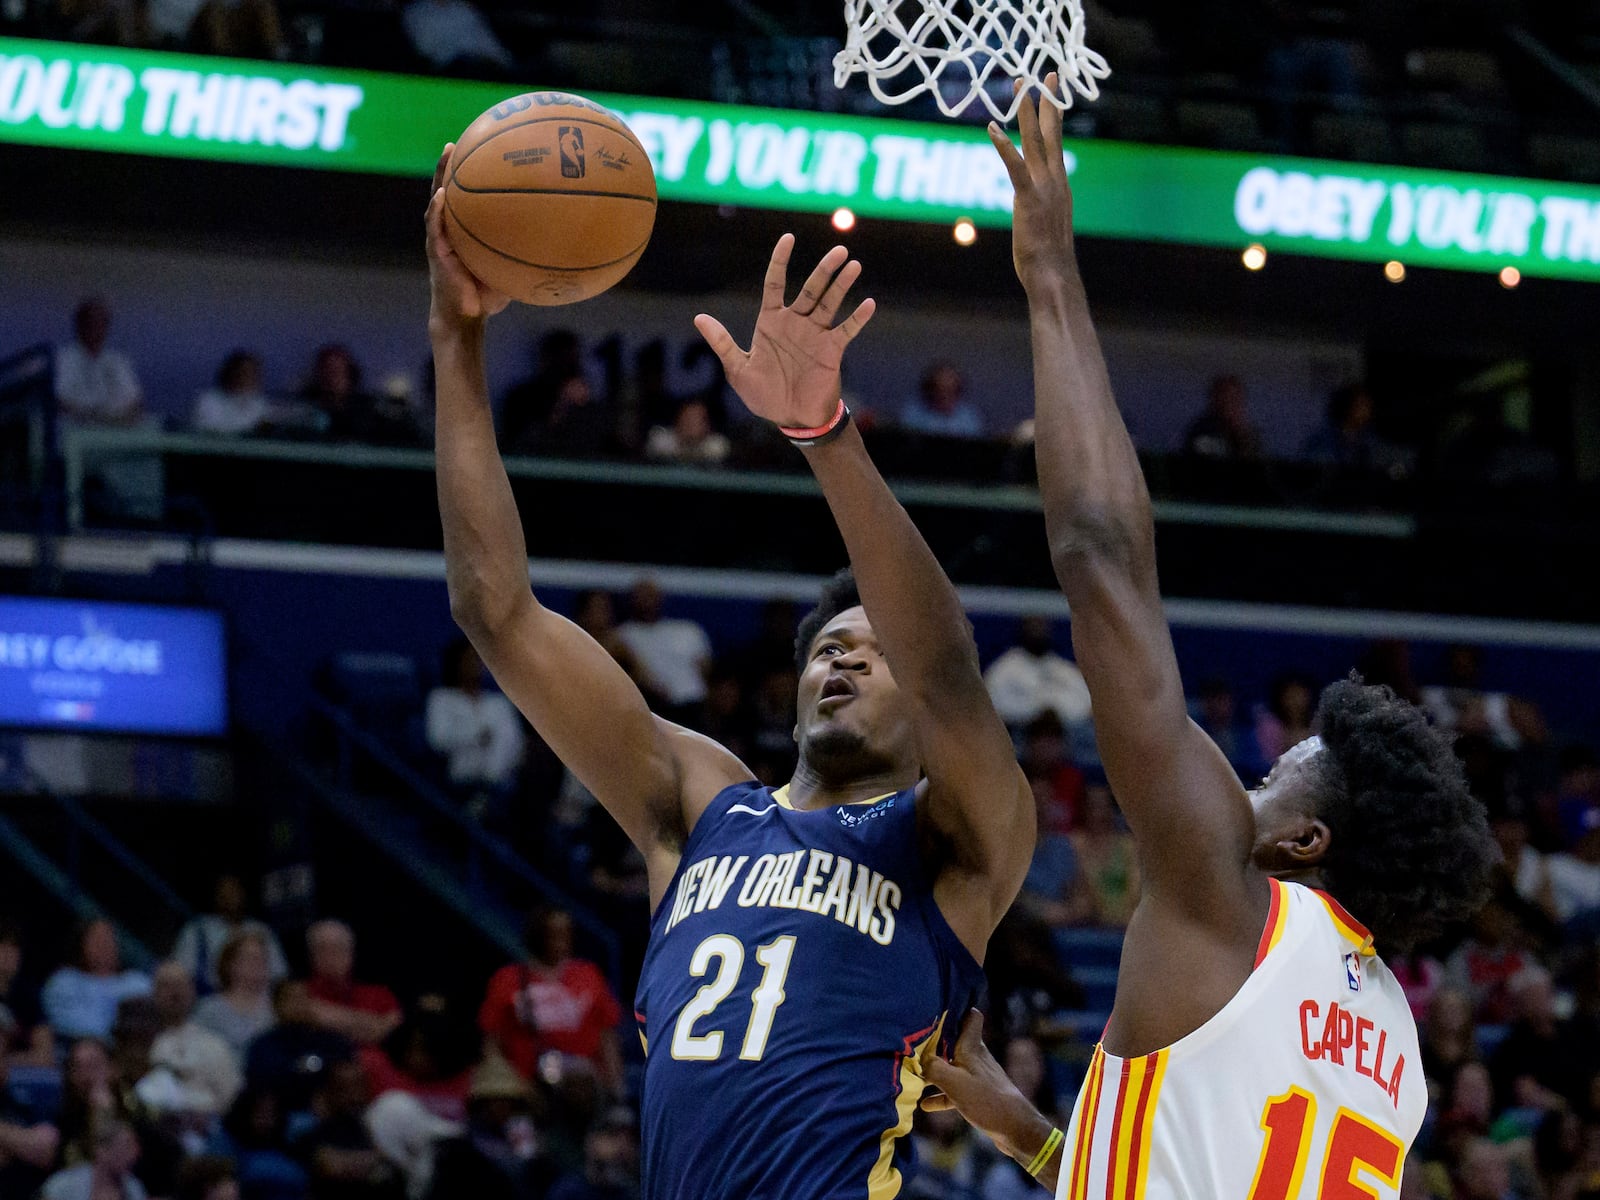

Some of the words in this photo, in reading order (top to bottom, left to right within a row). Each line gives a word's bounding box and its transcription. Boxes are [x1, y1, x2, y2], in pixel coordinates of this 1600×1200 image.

[0, 54, 136, 133] OUR
[140, 66, 364, 152] THIRST
[612, 110, 705, 182] EY
[703, 117, 869, 198] YOUR
[870, 133, 1077, 213] THIR
[1234, 166, 1386, 244] OBEY
[1386, 180, 1536, 257] YOUR
[664, 855, 750, 936] NEW
[737, 848, 902, 947] ORLEANS
[670, 933, 798, 1062] 21
[1298, 999, 1406, 1111] CAPELA
